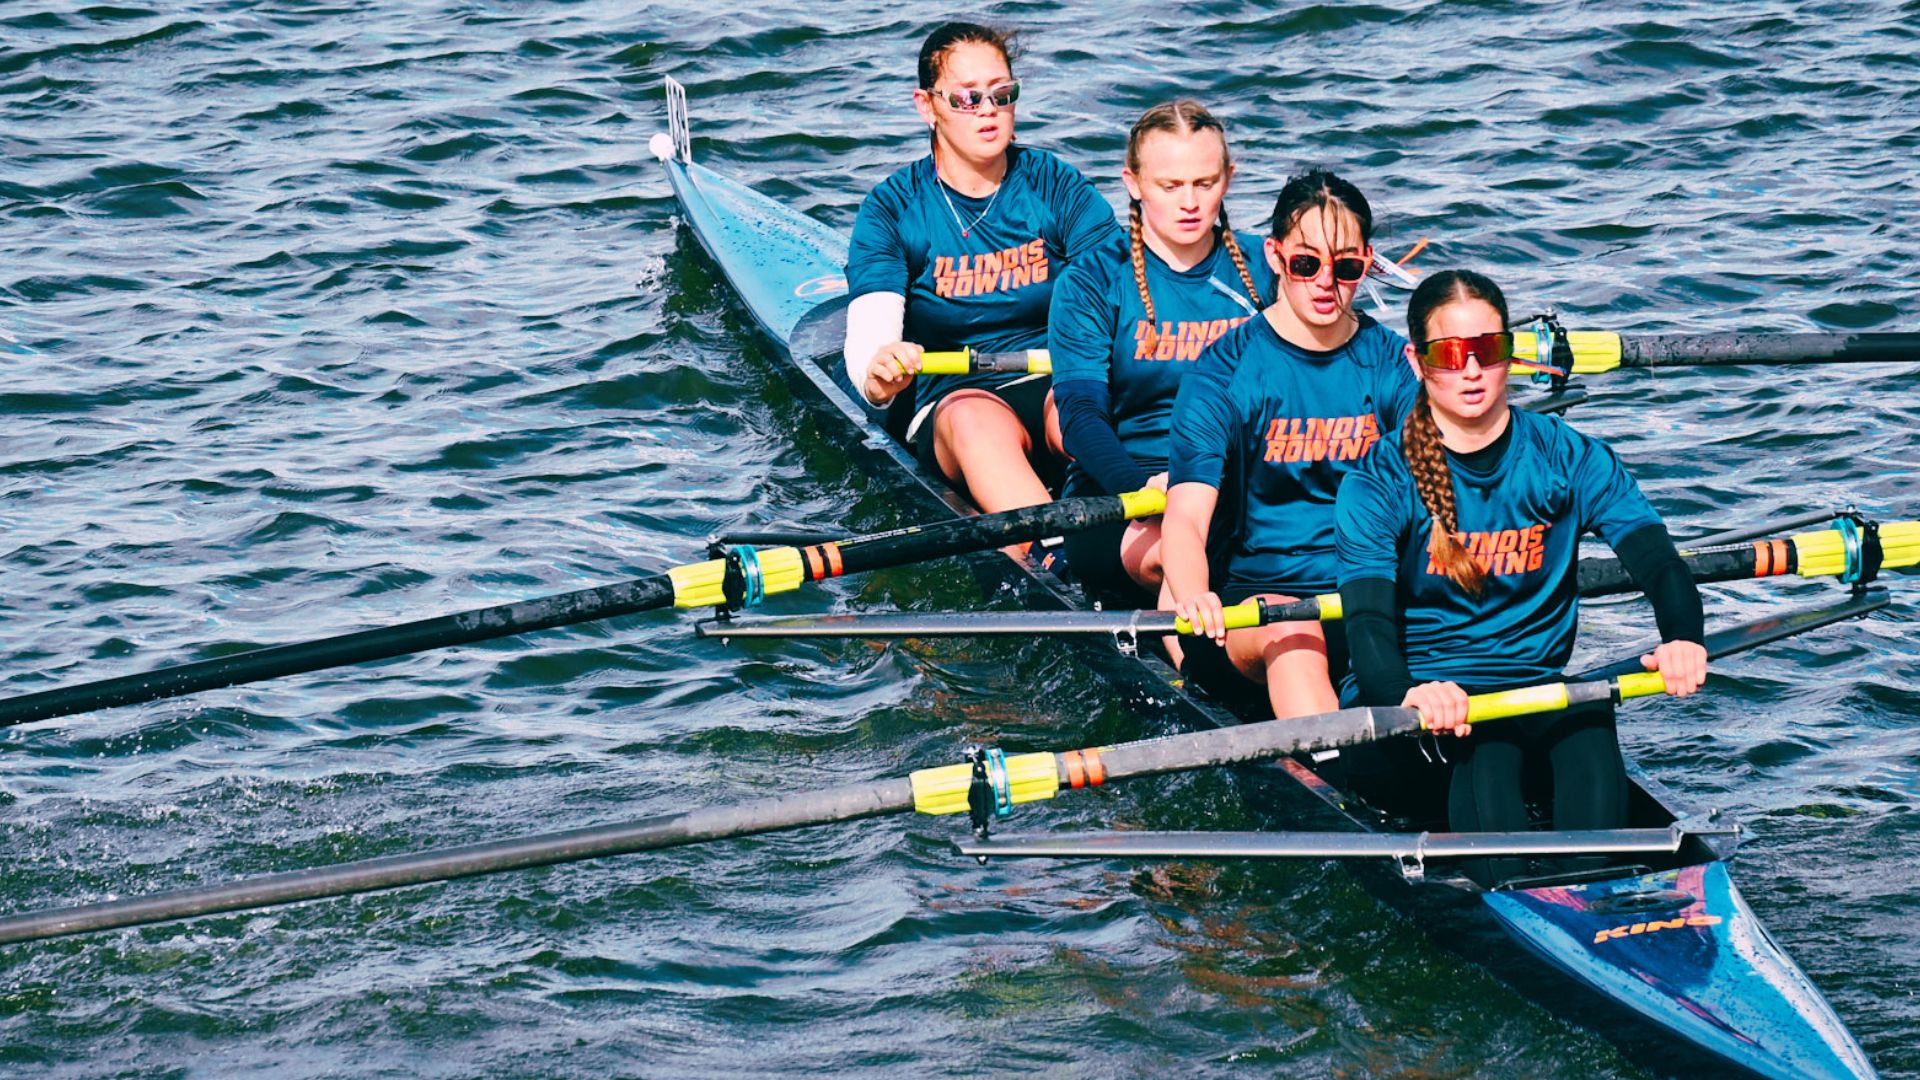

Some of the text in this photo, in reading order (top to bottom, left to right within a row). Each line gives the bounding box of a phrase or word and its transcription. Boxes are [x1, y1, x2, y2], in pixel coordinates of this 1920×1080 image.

[933, 238, 1045, 278] ILLINOIS
[935, 258, 1049, 298] ROWING
[1134, 315, 1251, 342] ILINO
[1134, 339, 1217, 361] ROW
[1265, 413, 1379, 441] ILLINOIS
[1426, 523, 1545, 554] LINOIS
[1426, 545, 1545, 577] RWING
